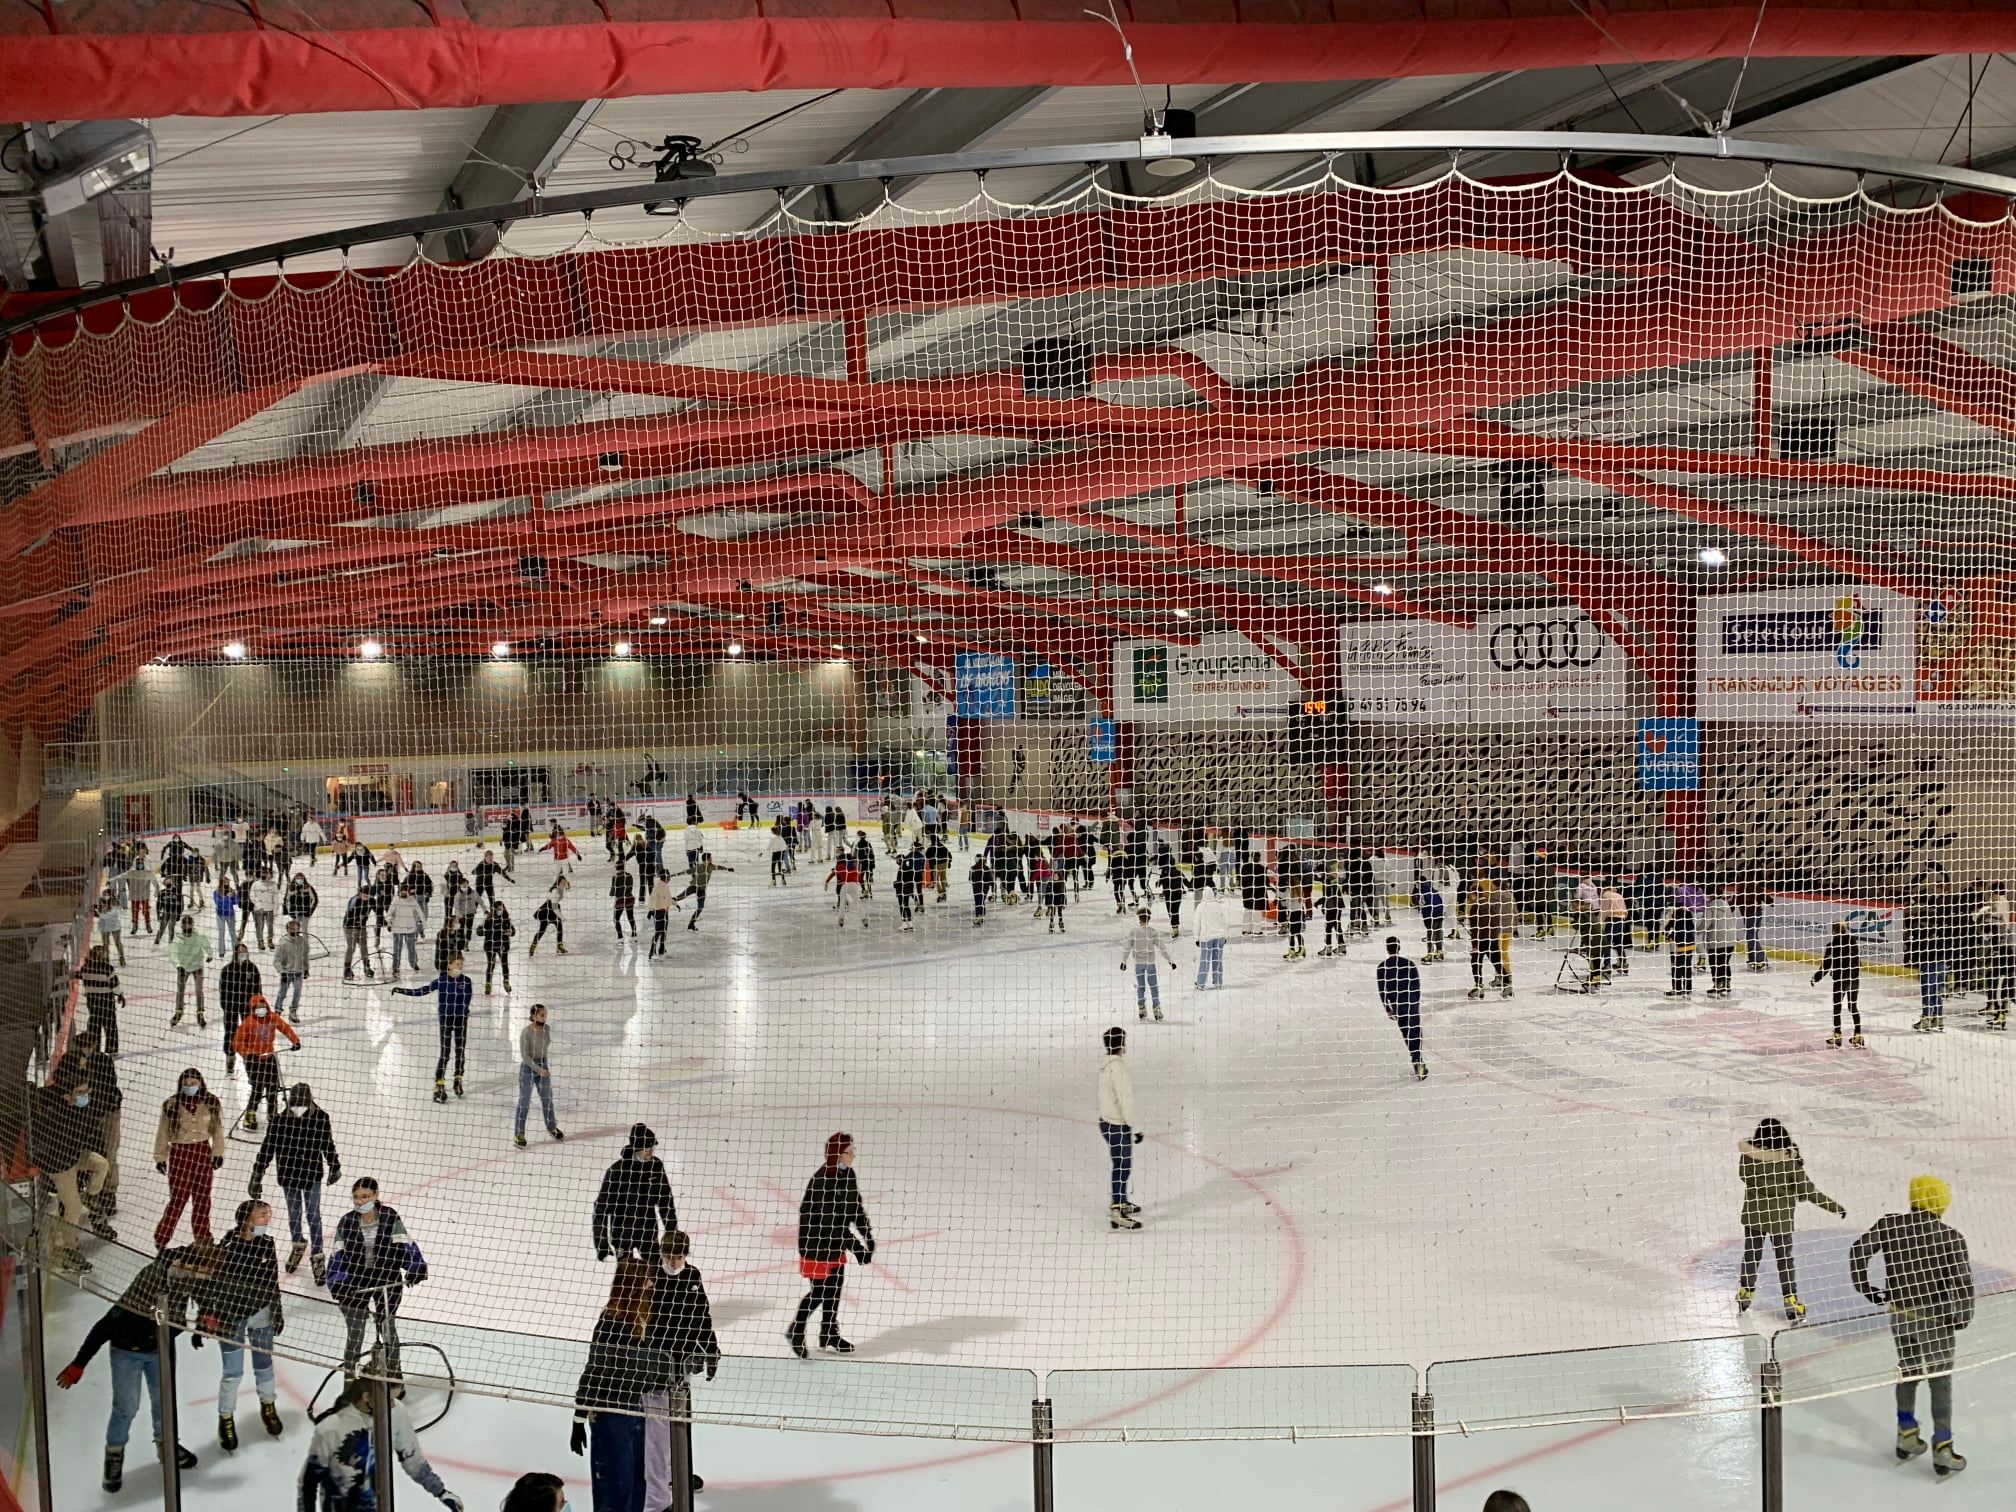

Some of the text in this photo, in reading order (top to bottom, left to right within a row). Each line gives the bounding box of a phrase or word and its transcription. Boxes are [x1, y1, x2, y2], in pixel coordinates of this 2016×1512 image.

[1176, 653, 1271, 680] Groupama
[1707, 675, 1902, 692] TRANSAZUR VOYAGES
